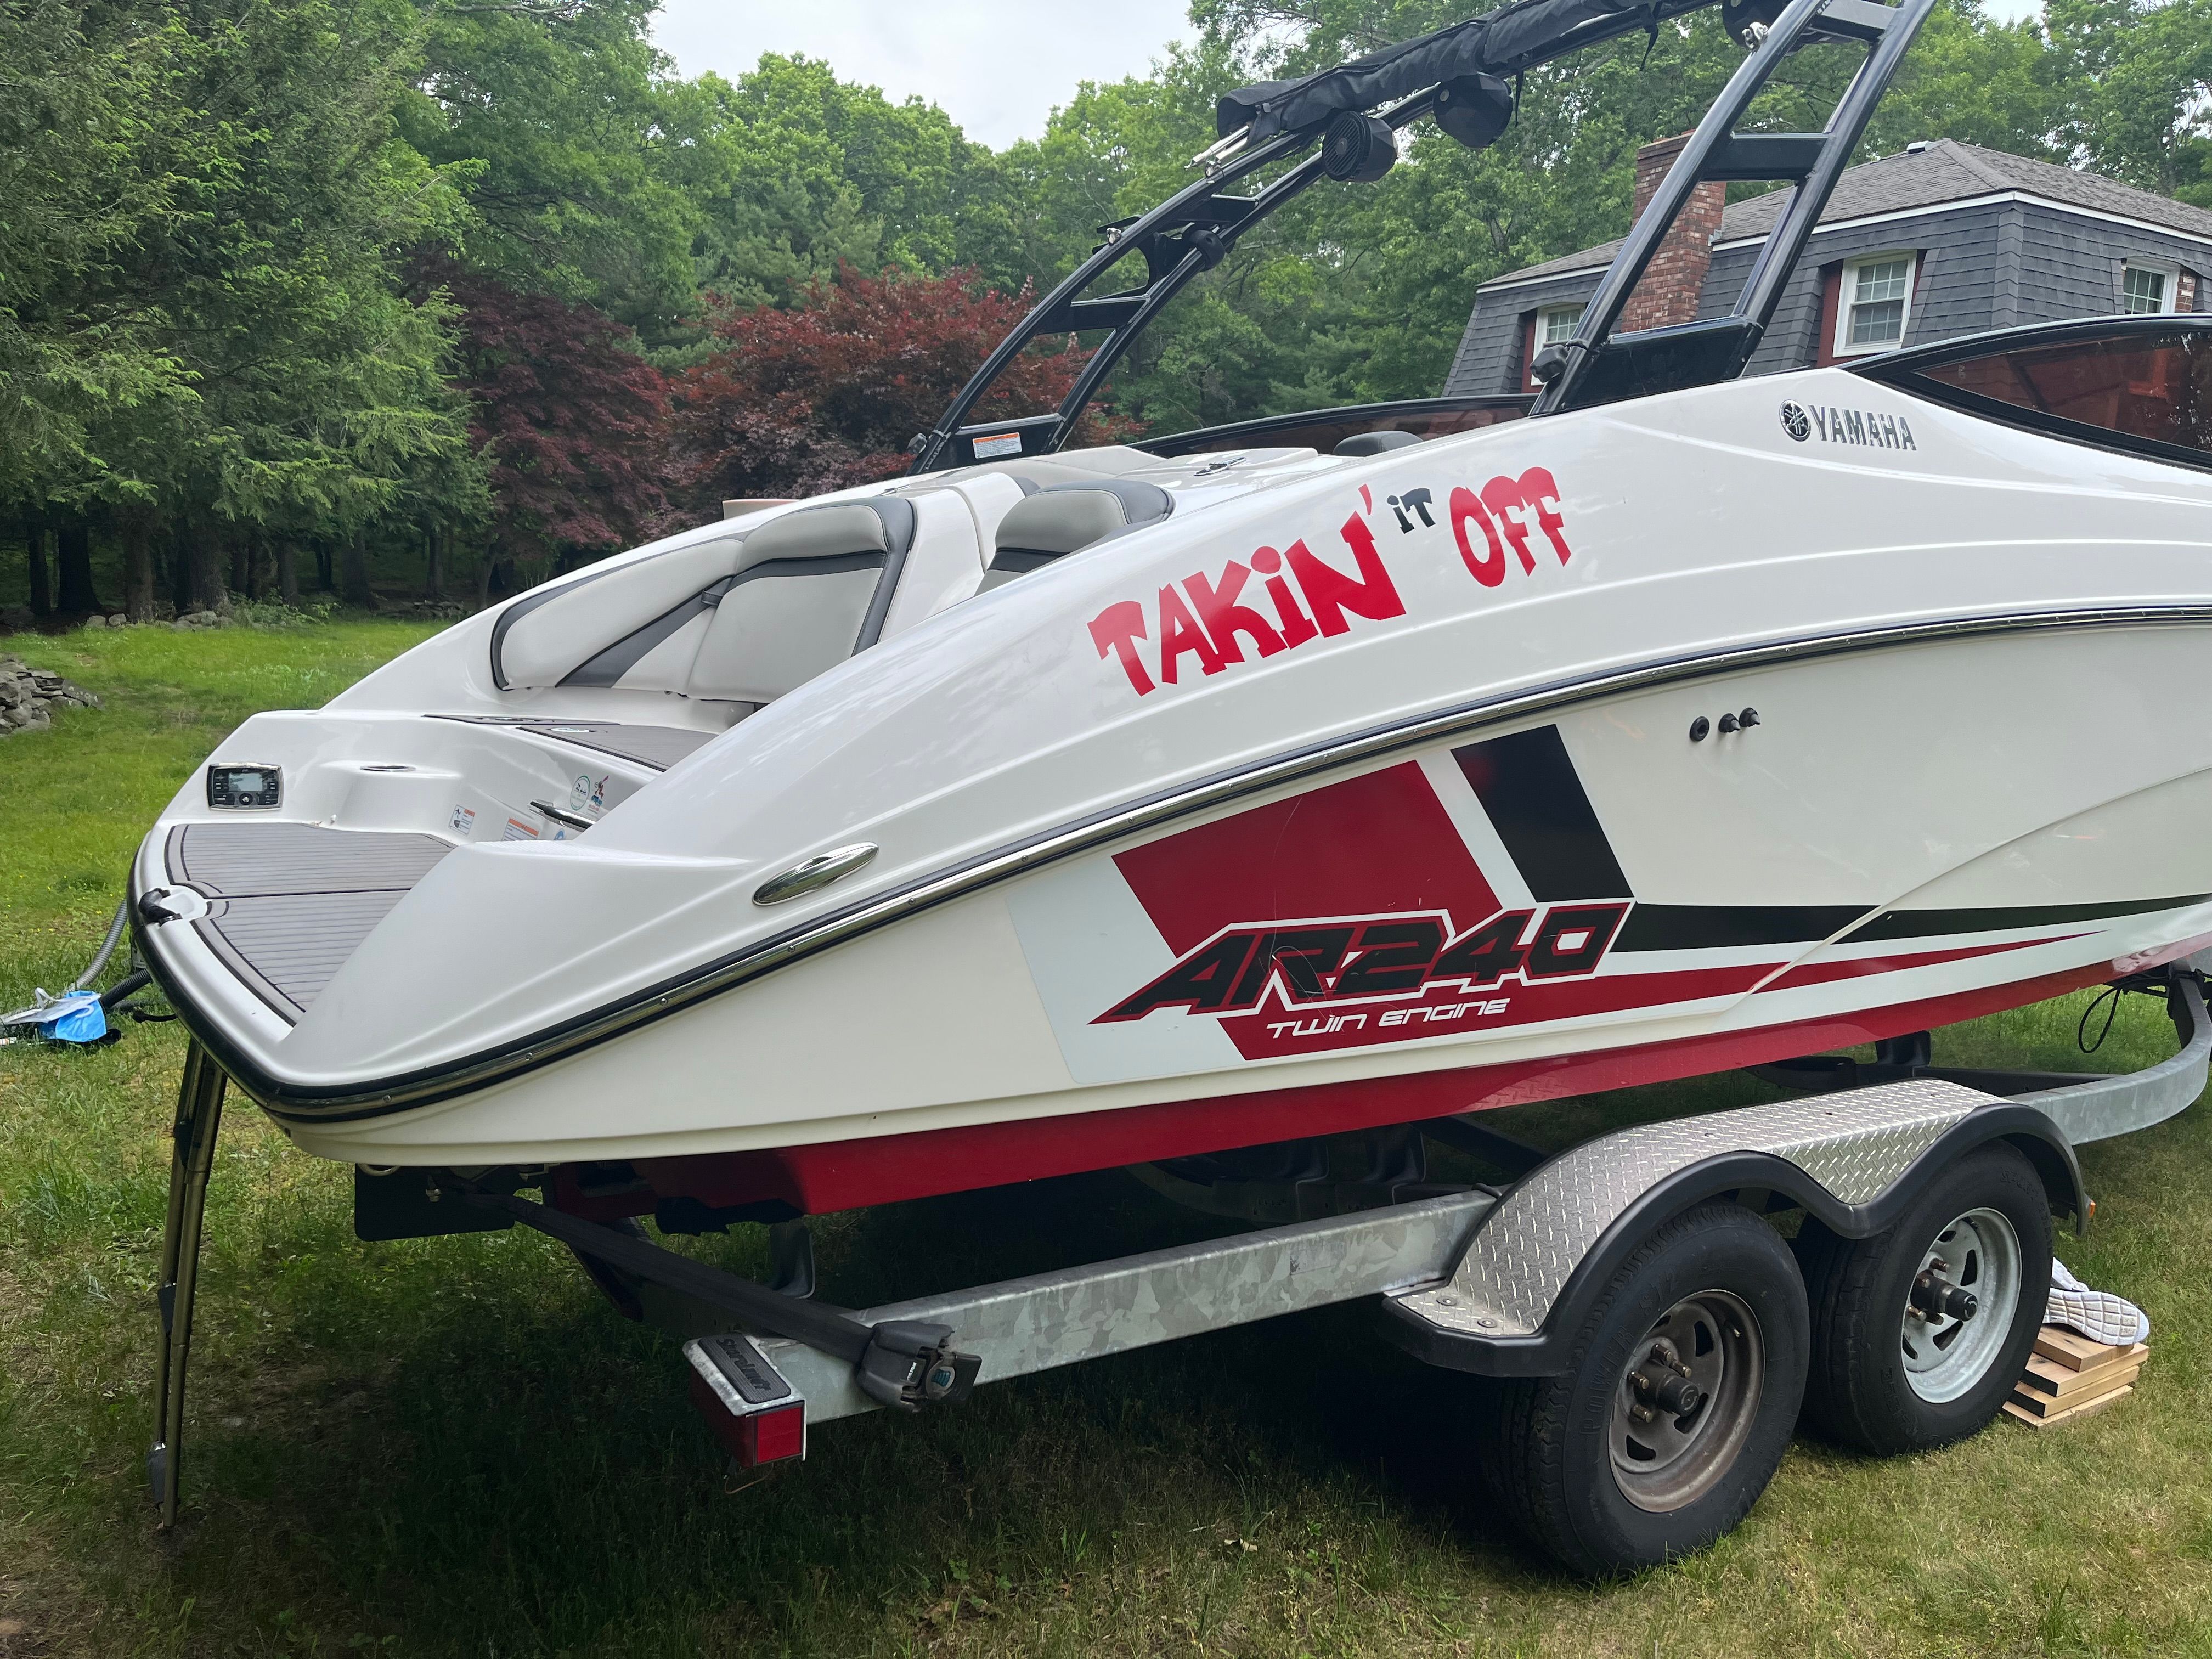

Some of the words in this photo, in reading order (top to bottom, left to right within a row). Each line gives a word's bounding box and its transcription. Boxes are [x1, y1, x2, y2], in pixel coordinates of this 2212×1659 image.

[1808, 404, 1917, 451] YAMAHA
[1449, 466, 1571, 588] OFF
[1088, 901, 1633, 1024] AR240
[1266, 1012, 1368, 1039] TWIN
[1379, 998, 1511, 1028] ENGINE
[1579, 1325, 1634, 1435] POWER
